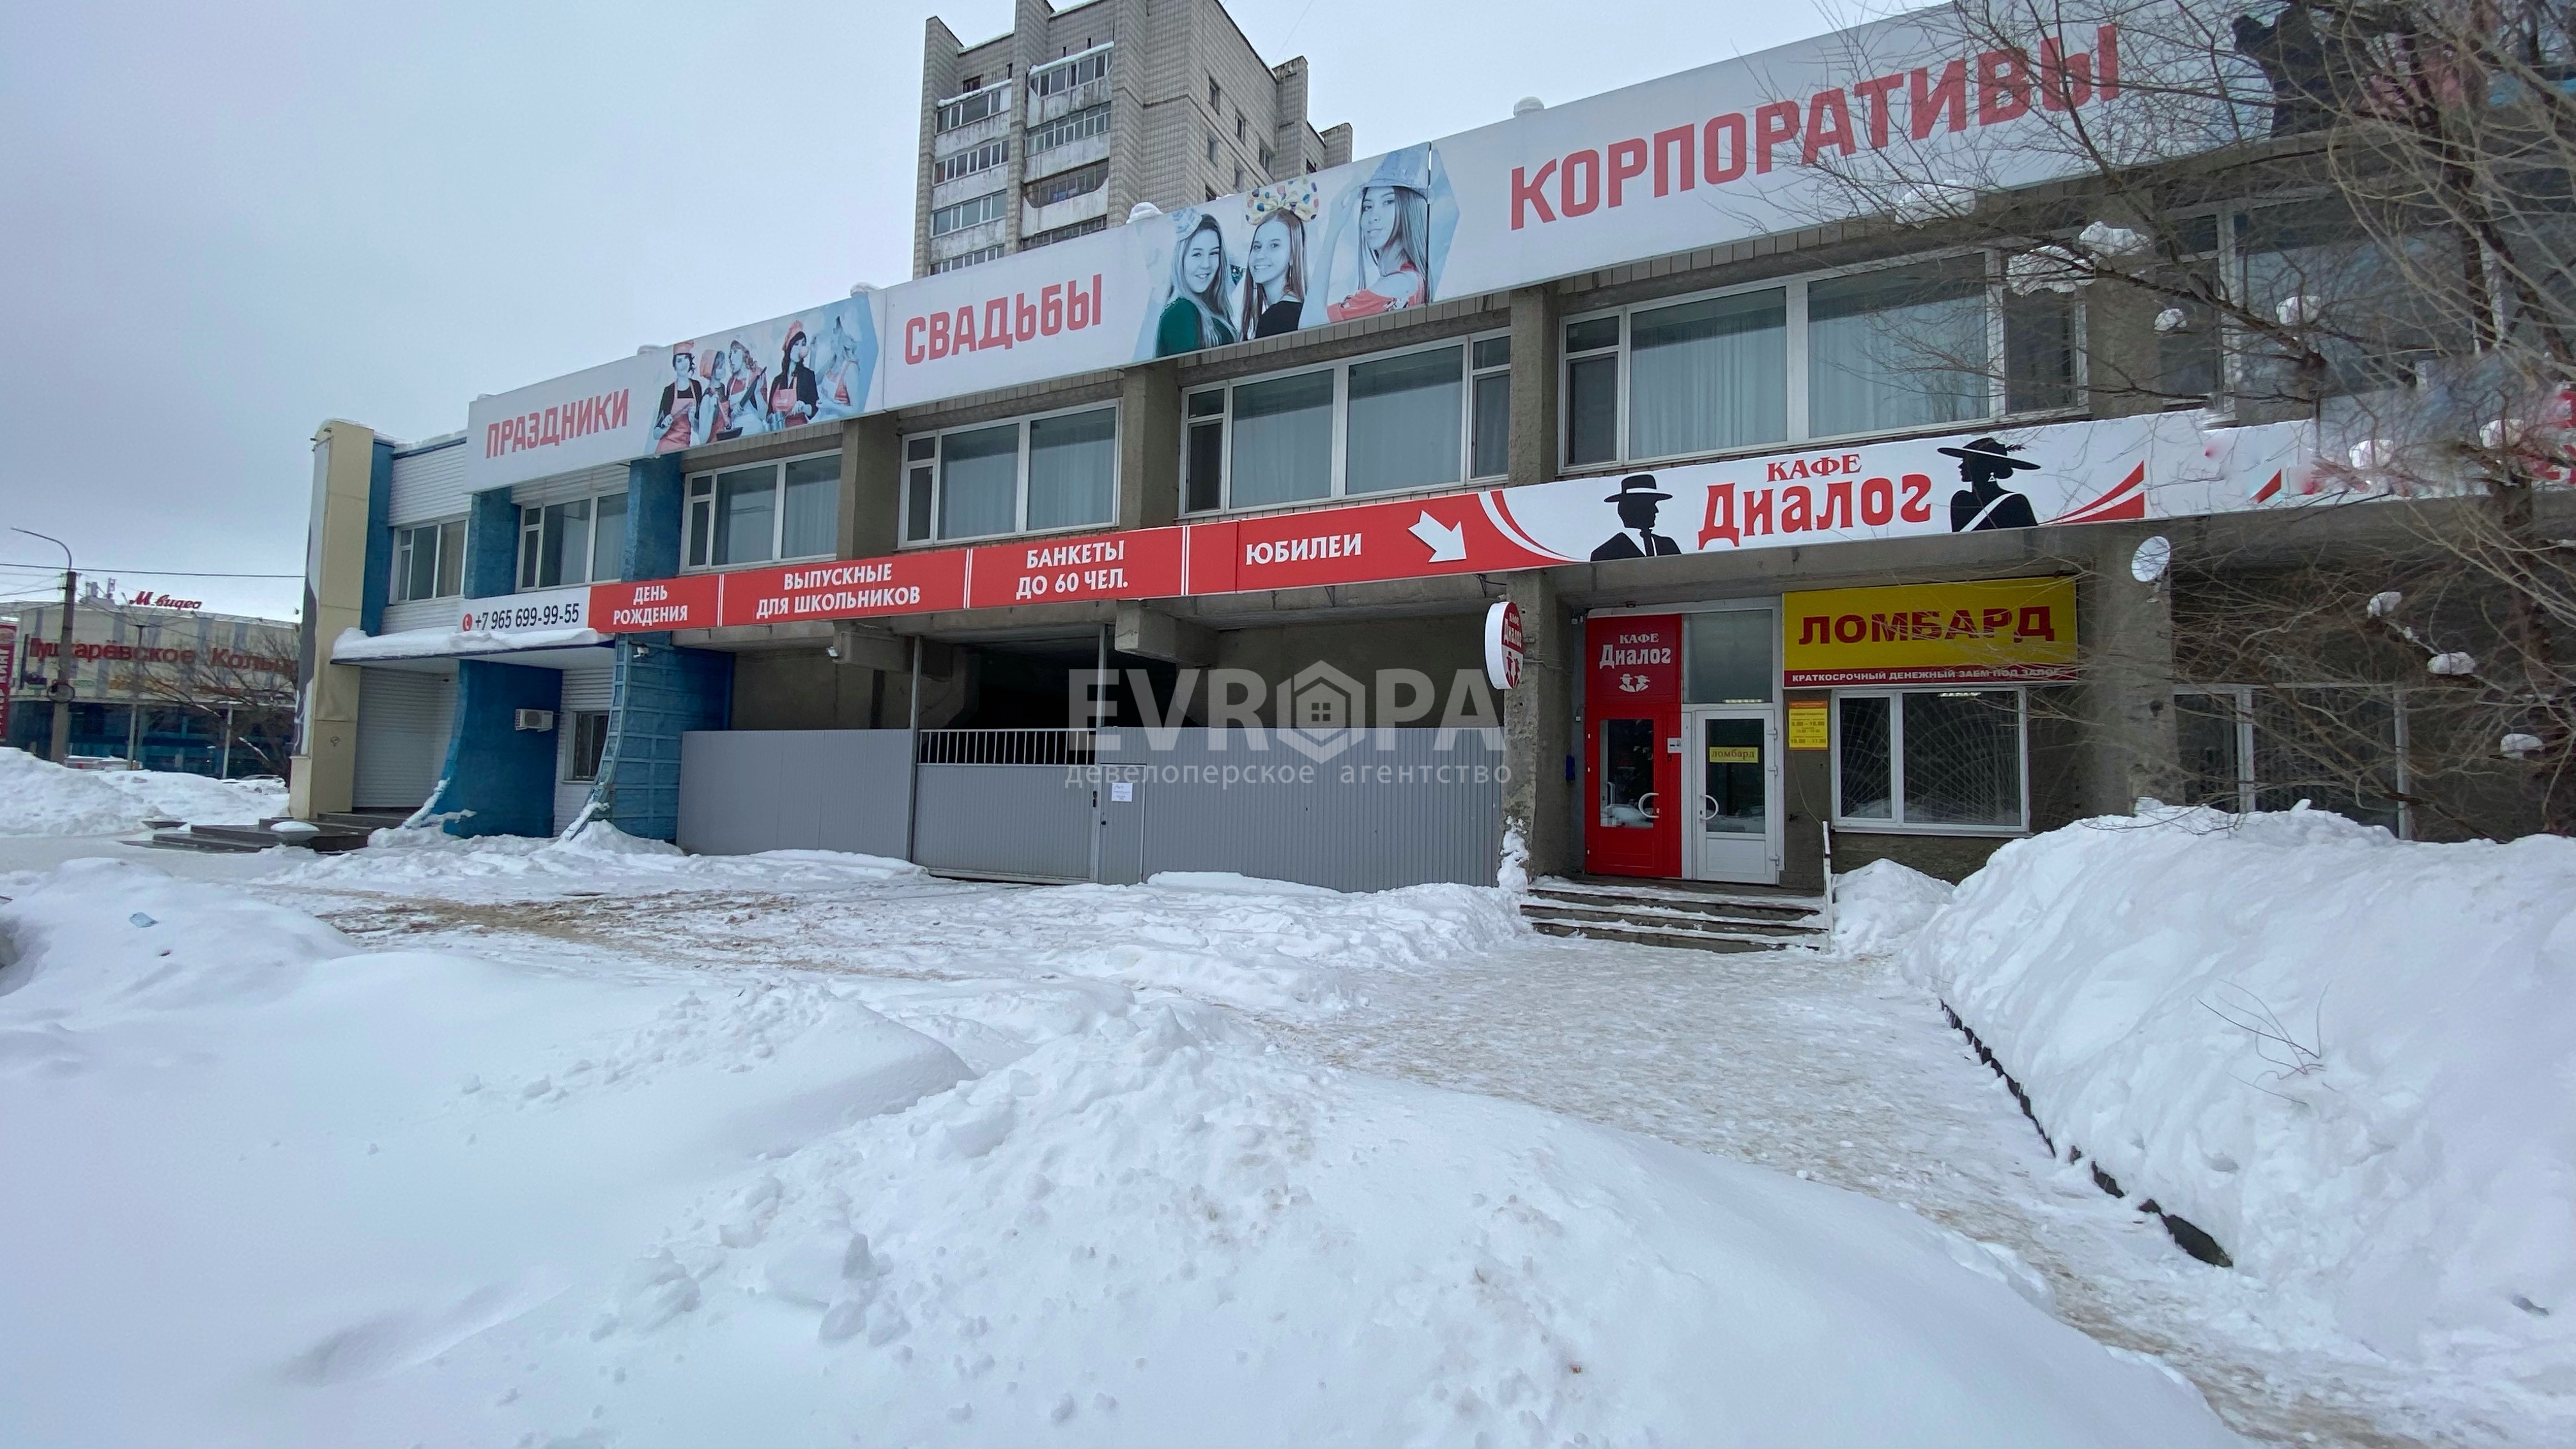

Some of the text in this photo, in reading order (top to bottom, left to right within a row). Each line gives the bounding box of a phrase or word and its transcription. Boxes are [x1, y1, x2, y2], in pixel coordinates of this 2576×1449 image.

[1512, 24, 2119, 231] КОРПОРАТИВЫ
[905, 274, 1102, 365] СВАДЬБЫ
[486, 388, 629, 459] ПРАЗДНИКИ
[1767, 453, 1862, 482] КАФЕ
[1698, 473, 1932, 550] Диалог
[1027, 540, 1124, 569] БАНКЕТЫ
[1246, 533, 1361, 565] ЮБИЛЕИ
[783, 564, 892, 590] ВЫПУСКНЫЕ
[1016, 568, 1129, 600] ДО 60 ЧЕЛ.
[633, 585, 668, 605] ДЕНЬ
[756, 587, 921, 619] ДЛЯ ШКОЛЬНИКОВ
[475, 602, 579, 631] +7 965 699-99-55
[613, 605, 688, 625] РОЖДЕНИЯ
[1798, 606, 2055, 645] ЛОМБАРД
[1620, 633, 1659, 644] КАФЕ
[1599, 644, 1671, 670] Диалог
[1792, 672, 1886, 682] КРАТКОСРОЧНЫЙ
[1889, 668, 1956, 680] ДЕНЕЖНЫЙ
[1959, 669, 1990, 677] ЗАЕМ
[1993, 669, 2018, 677] ПОД
[1711, 750, 1755, 760] ломбард
